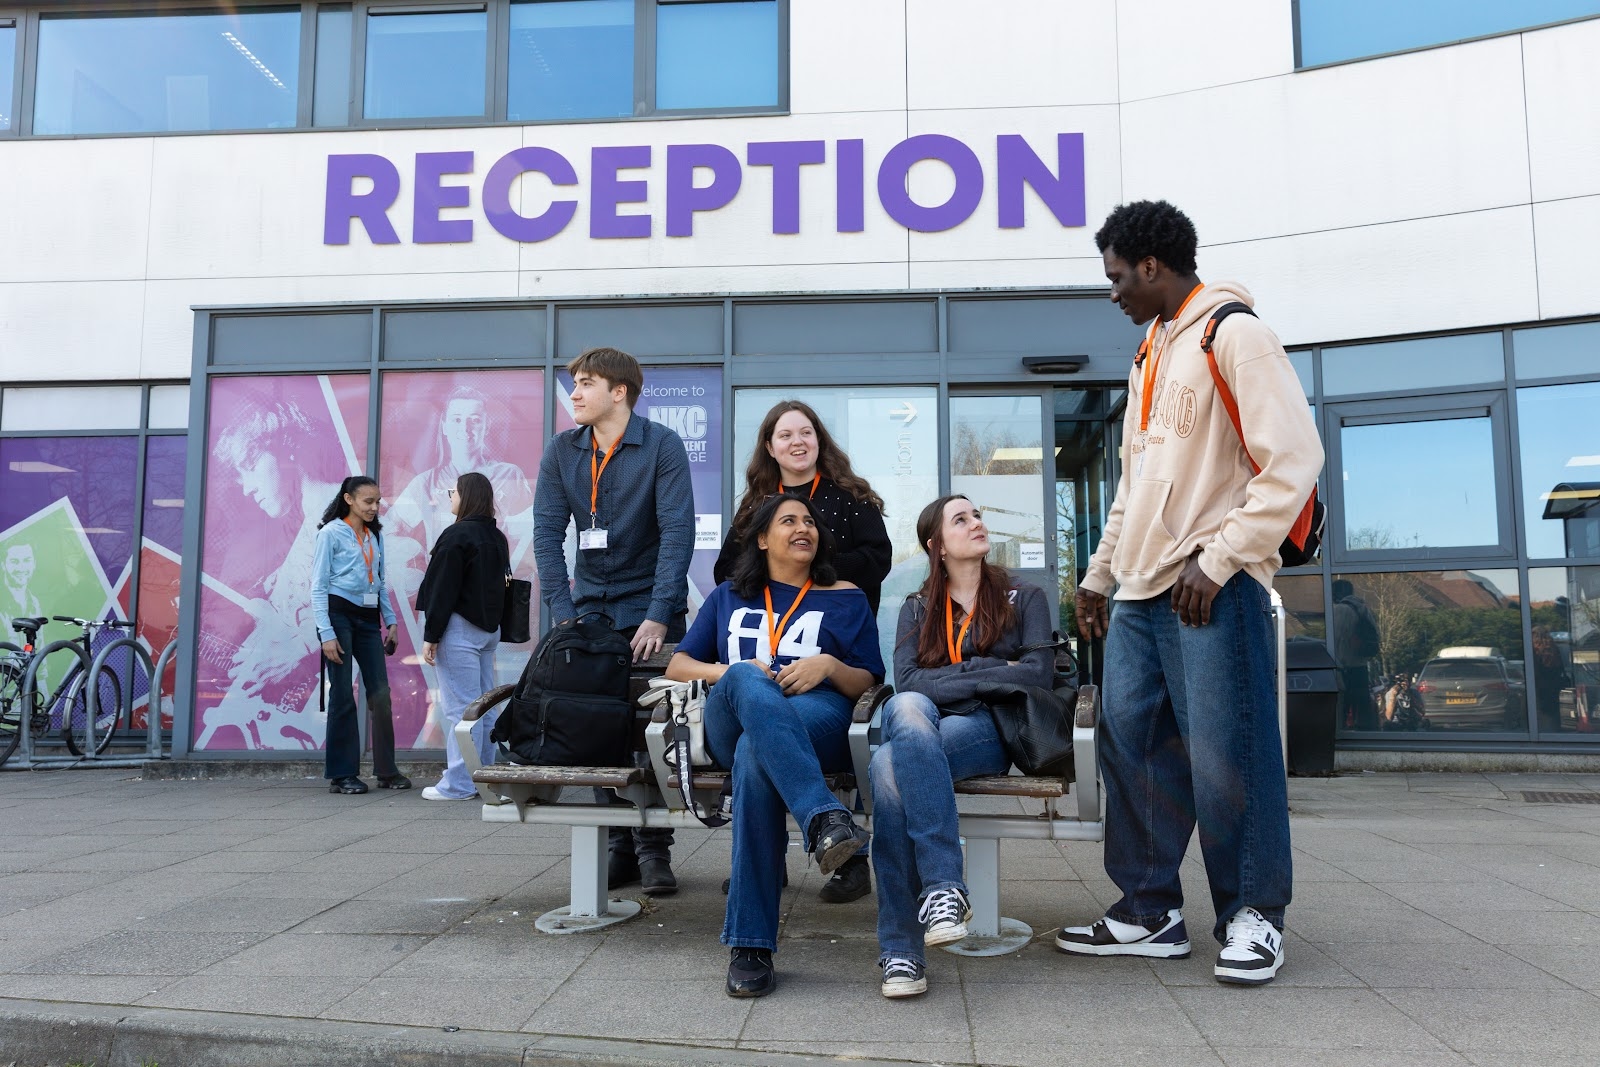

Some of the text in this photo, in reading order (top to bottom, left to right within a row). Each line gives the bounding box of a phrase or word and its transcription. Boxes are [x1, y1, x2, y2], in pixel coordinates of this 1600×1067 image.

[323, 132, 1087, 245] RECEPTION
[639, 384, 705, 397] elcome to
[727, 607, 825, 666] 84
[678, 746, 691, 792] MARC
